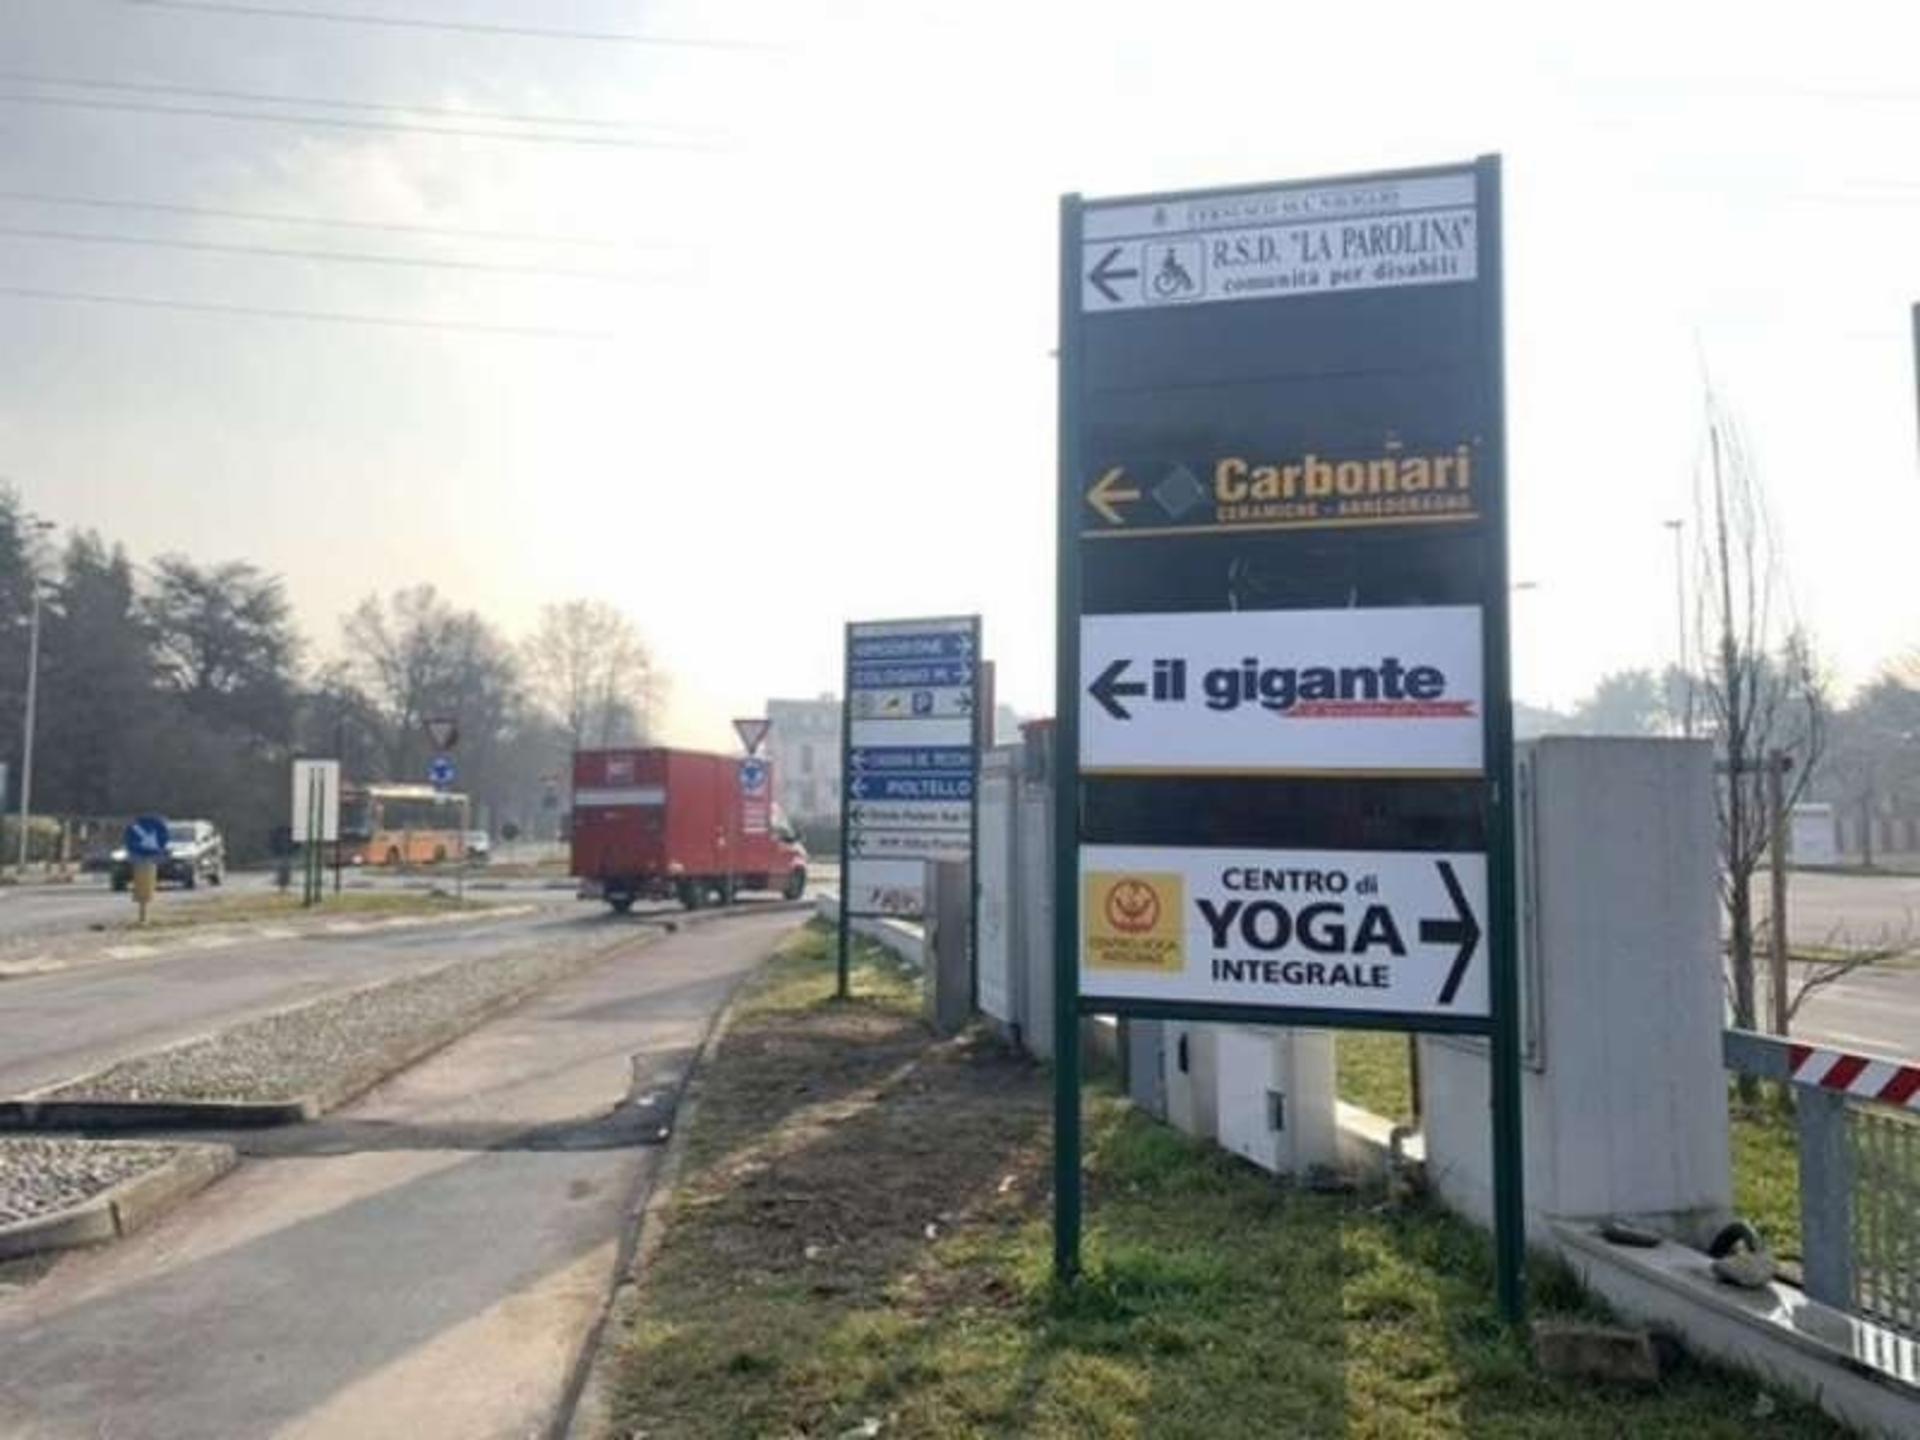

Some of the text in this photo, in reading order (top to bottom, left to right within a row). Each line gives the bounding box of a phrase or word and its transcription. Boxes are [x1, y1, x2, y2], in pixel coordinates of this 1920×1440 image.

[1330, 267, 1361, 287] per
[1374, 254, 1458, 281] disabili
[1215, 444, 1470, 501] Carbonari
[1153, 657, 1446, 711] il gigante
[1221, 867, 1379, 896] CENTRO di
[1195, 899, 1407, 957] YOGA
[1211, 959, 1391, 989] INTEGRALE
